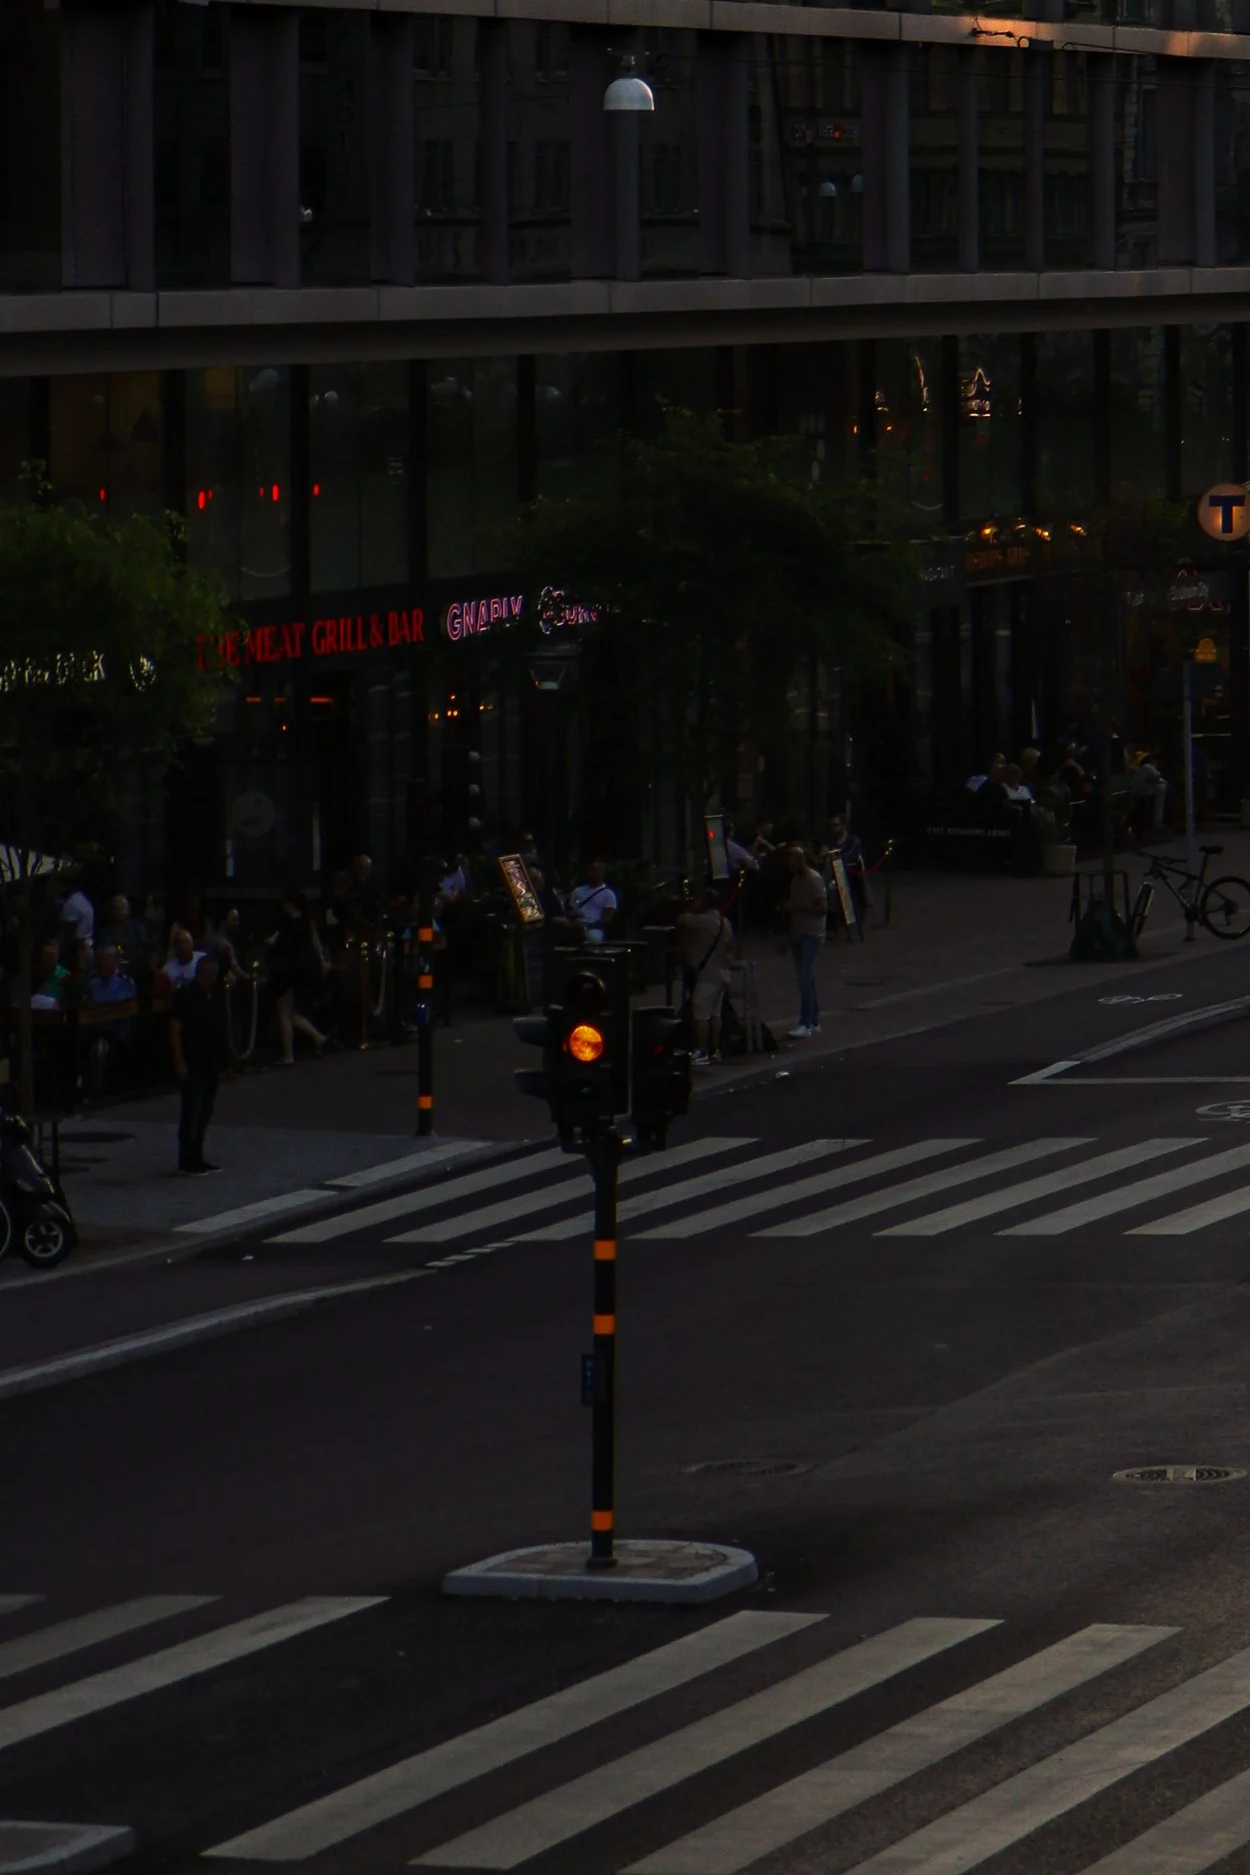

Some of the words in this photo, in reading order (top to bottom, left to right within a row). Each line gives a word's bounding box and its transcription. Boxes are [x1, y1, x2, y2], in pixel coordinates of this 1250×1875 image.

[1209, 495, 1245, 534] T
[244, 621, 306, 666] MEAT
[311, 613, 368, 657] GRILL
[387, 606, 425, 646] BAR
